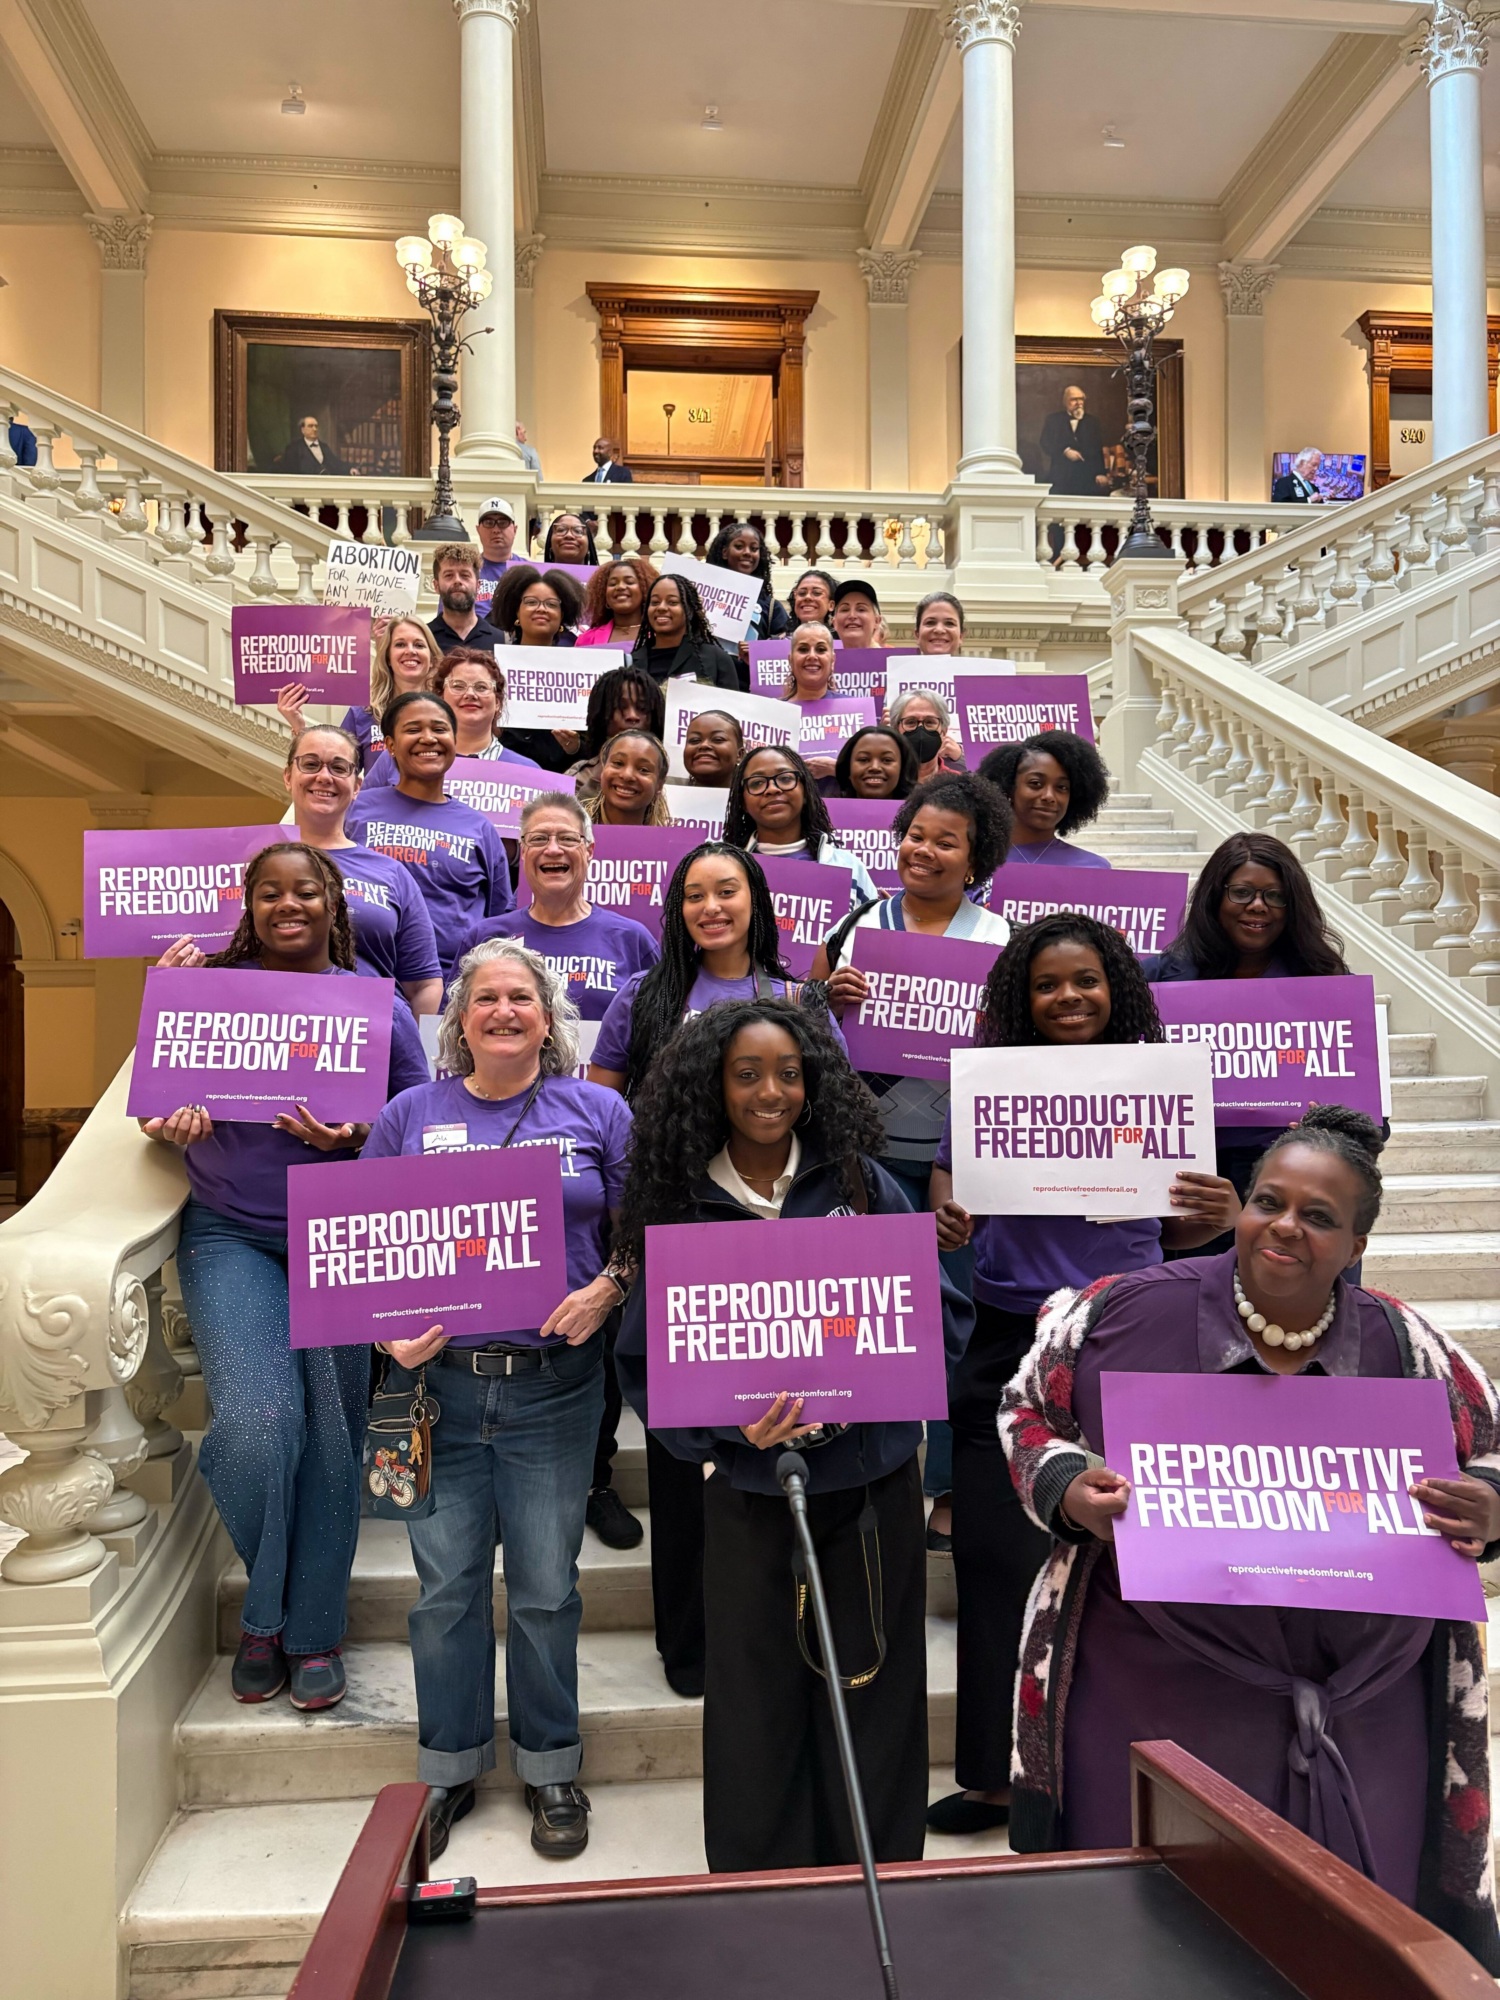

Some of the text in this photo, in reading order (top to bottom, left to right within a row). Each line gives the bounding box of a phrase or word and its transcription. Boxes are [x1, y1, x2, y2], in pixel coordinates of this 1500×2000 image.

[688, 408, 712, 423] 341
[1400, 428, 1426, 444] 340
[330, 545, 420, 578] ABORTION,
[328, 568, 407, 591] FOR ANYONE.
[325, 585, 387, 604] ANY TIME.
[715, 602, 727, 610] FOR
[723, 605, 743, 622] ALL
[240, 634, 357, 655] REPRODUCTIVE
[241, 654, 357, 674] FREEDOM FOR ALL
[507, 669, 600, 689] REPRODUCTI
[507, 685, 577, 704] FREEDOM
[800, 713, 864, 728] DUCTIVE
[966, 703, 1080, 724] REPRODUCTIVE
[824, 726, 839, 734] FOR
[969, 723, 1040, 743] FREEDOM
[366, 821, 475, 850] REPRODUCTIVE
[365, 833, 471, 864] FREEDOM FOR ALL
[100, 863, 249, 891] REPRODUCT
[631, 883, 652, 896] FOR
[100, 889, 219, 916] FREEDOM
[218, 888, 242, 901] FOR
[364, 891, 391, 911] ALL
[1125, 930, 1163, 954] ALL
[568, 972, 587, 982] FOR
[585, 972, 617, 992] ALL
[155, 1011, 369, 1044] REPRODUCTIVE
[858, 999, 977, 1038] FREEDOM
[1165, 1020, 1354, 1050] EPRODUCTIVE
[152, 1039, 366, 1073] FREEDOM FOR ALL
[1278, 1050, 1306, 1065] FOR
[1304, 1049, 1356, 1077] ALL
[205, 1093, 308, 1103] reproductivefreedomforall.org
[973, 1093, 1195, 1127] REPRODUCTIVE
[974, 1126, 1196, 1160] FREEDOM FOR ALL
[1032, 1184, 1138, 1195] reproductivefreedomforall.org
[307, 1198, 539, 1253] REPRODUCTIVE
[308, 1234, 541, 1289] FREEDOM FOR ALL
[372, 1302, 482, 1319] reproductivefreedomforall.org
[666, 1275, 914, 1324] REPRODUCTIVE
[667, 1315, 917, 1363] FREEDOM FOR ALL
[734, 1388, 853, 1401] reproductivreedomforall.org
[1130, 1443, 1425, 1492] REPRODUCTIVE
[1134, 1486, 1442, 1537] FREEDOM FOR ALL
[1228, 1563, 1374, 1581] reproductivefreedomforall.org
